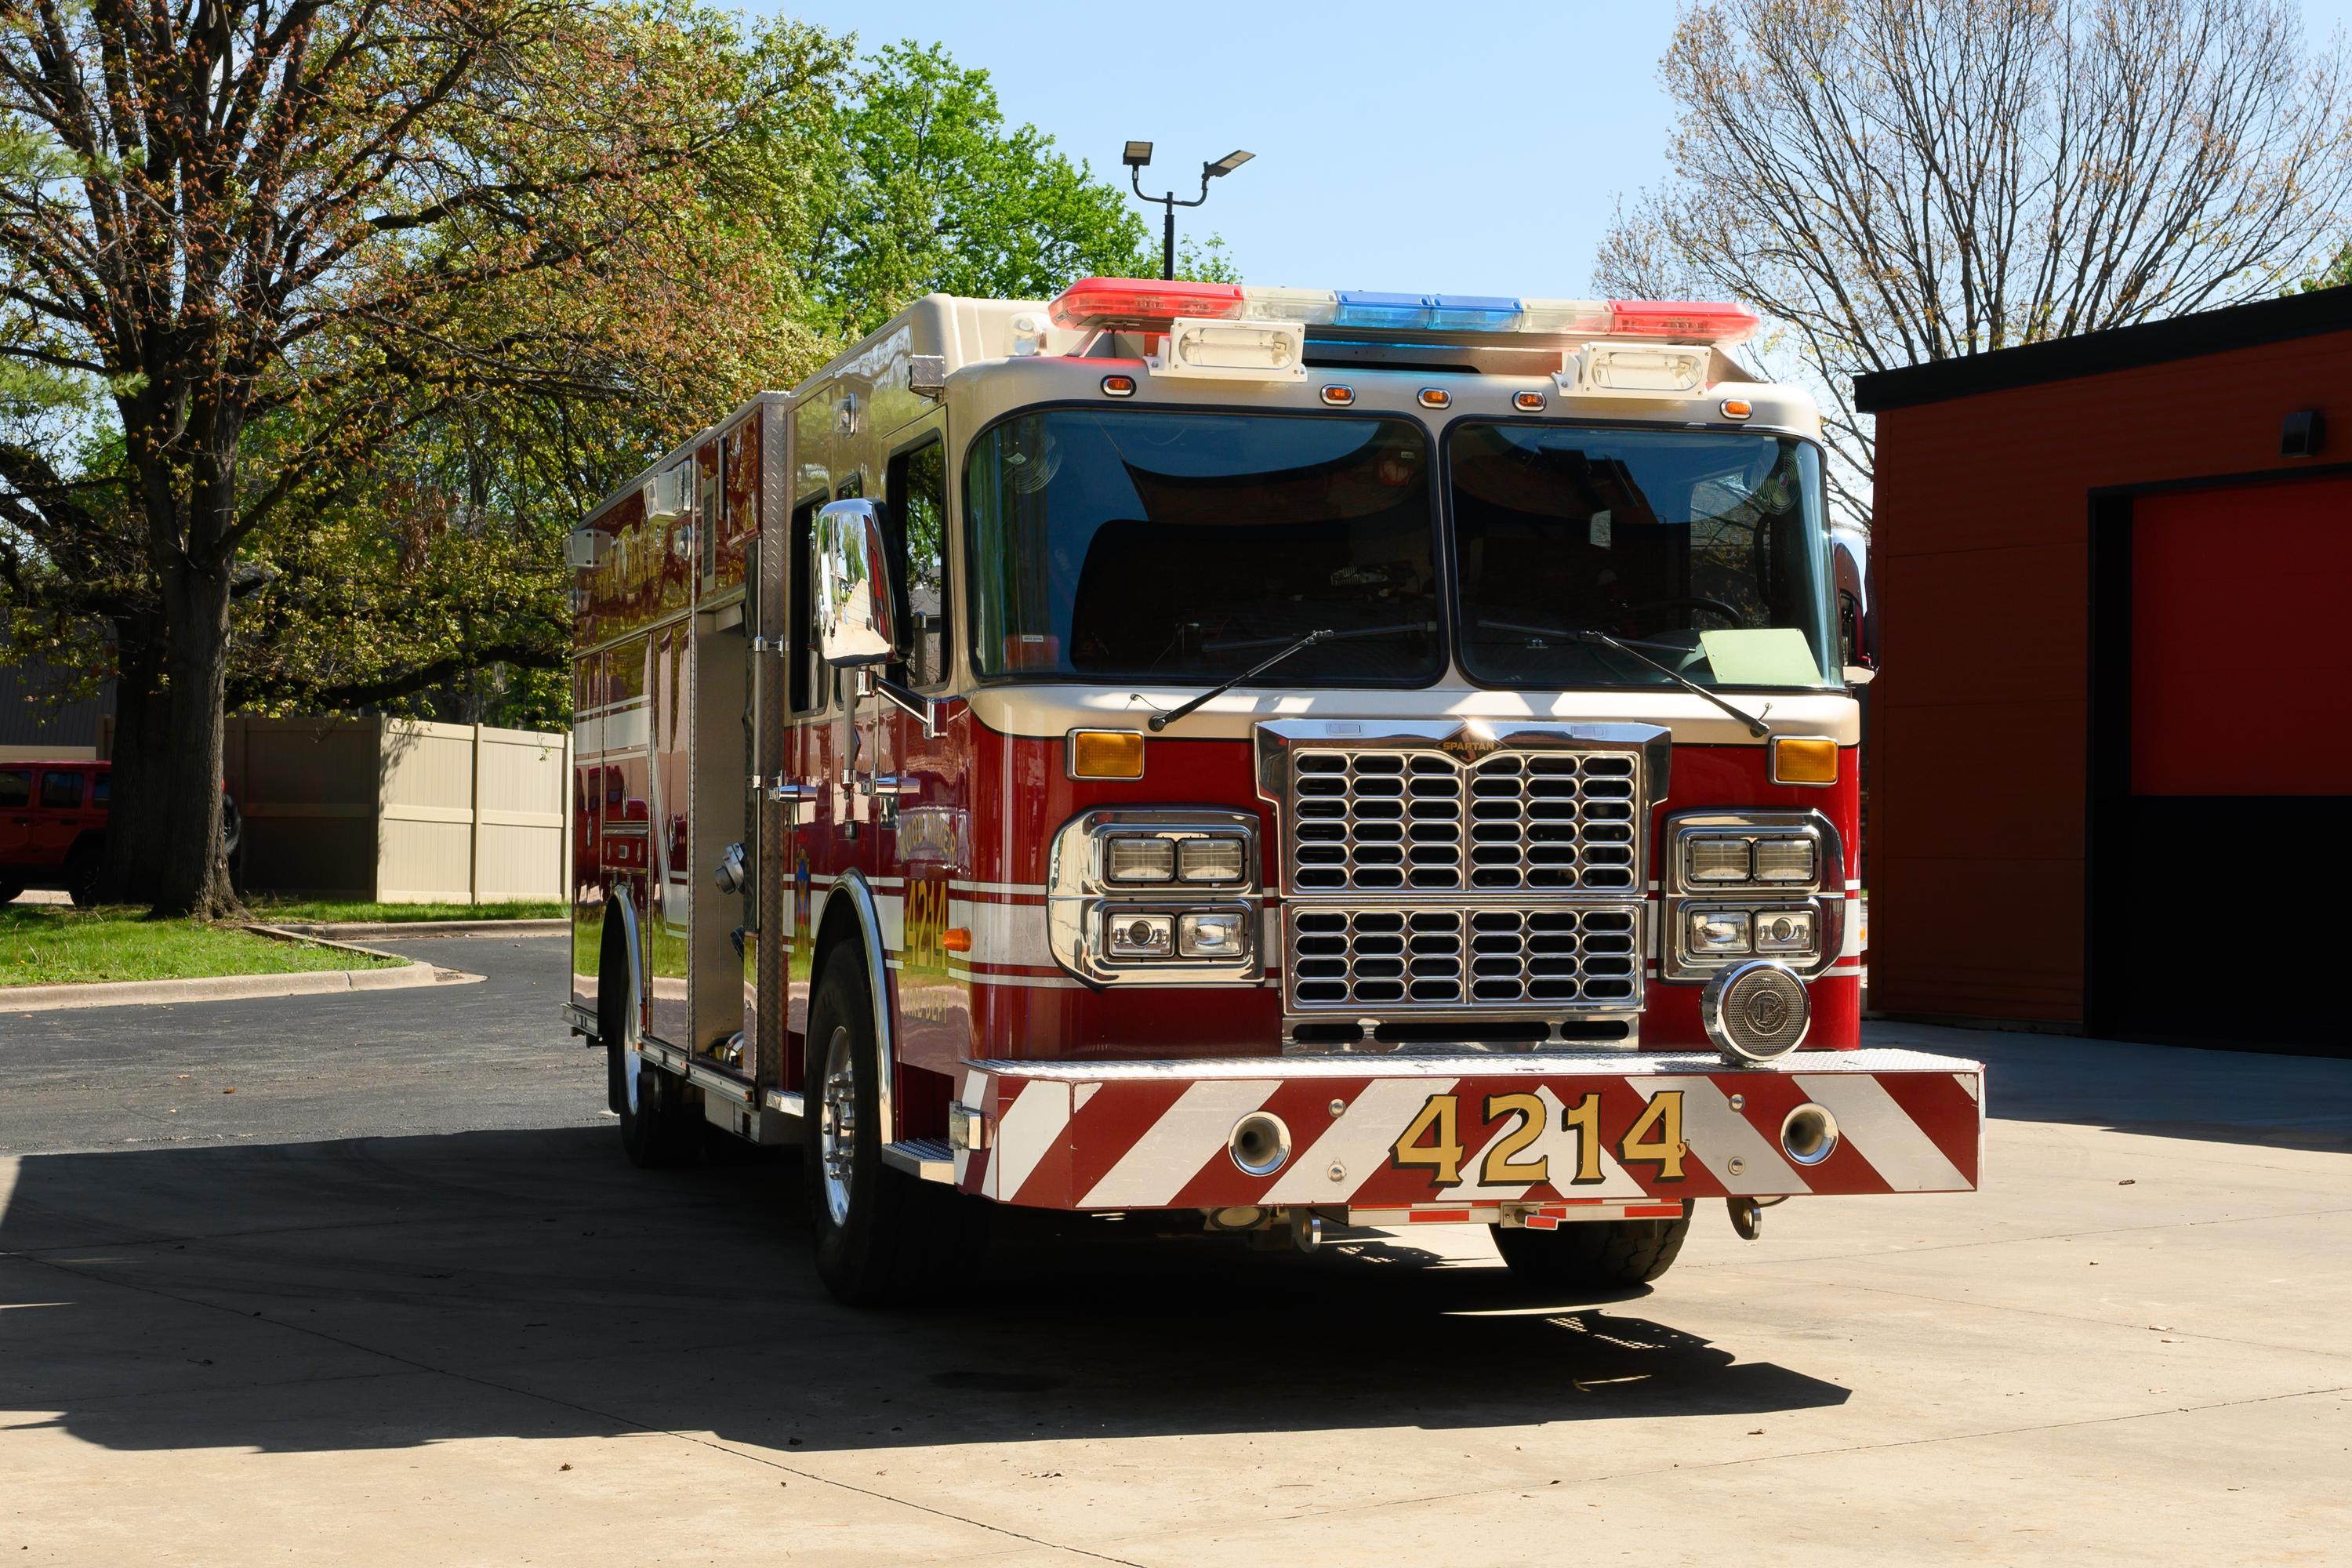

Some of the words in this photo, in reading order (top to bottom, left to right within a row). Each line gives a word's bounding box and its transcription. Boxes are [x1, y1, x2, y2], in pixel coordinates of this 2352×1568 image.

[1443, 740, 1494, 751] SPARTAN
[898, 813, 924, 863] WOOD
[906, 879, 947, 972] 4214
[925, 989, 948, 1024] DEPT
[1388, 1091, 1686, 1188] 4214
